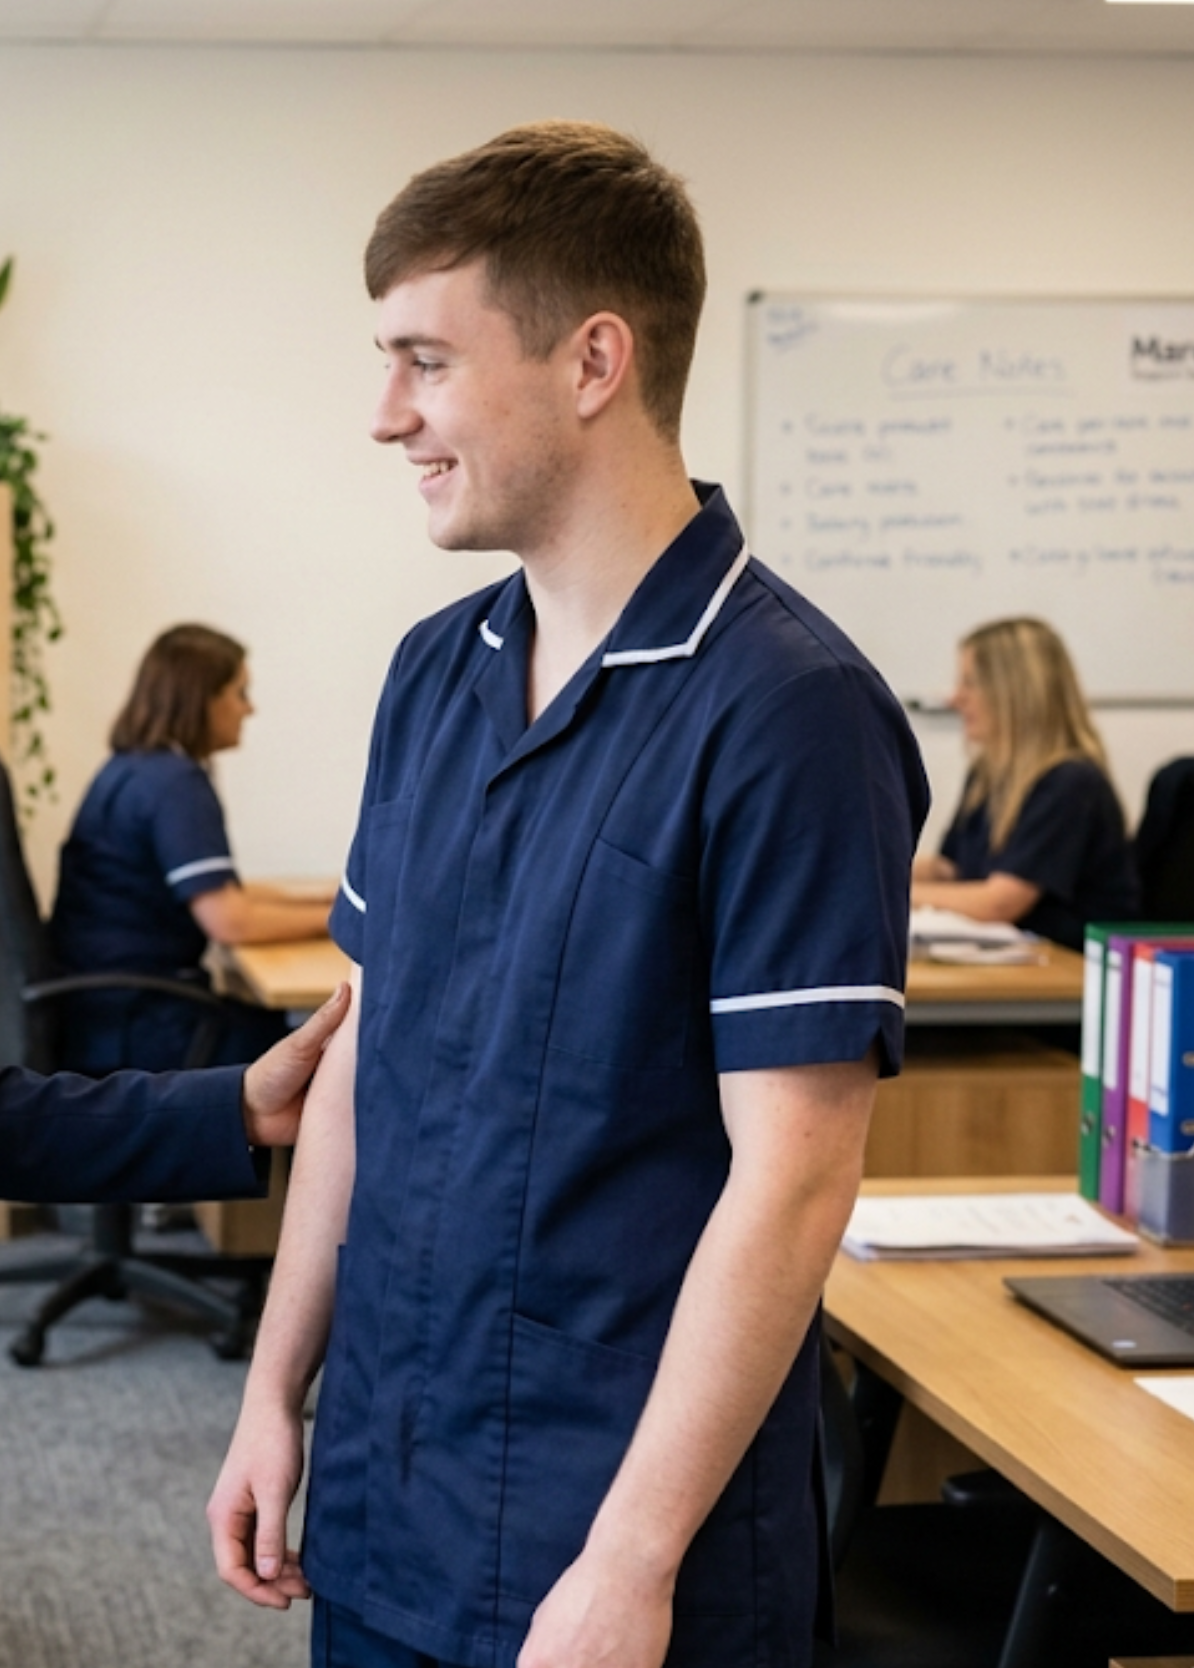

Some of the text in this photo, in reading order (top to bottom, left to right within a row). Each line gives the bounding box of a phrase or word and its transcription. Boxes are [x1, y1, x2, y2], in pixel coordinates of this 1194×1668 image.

[881, 342, 1067, 387] Care Notes
[1131, 335, 1194, 363] Mar
